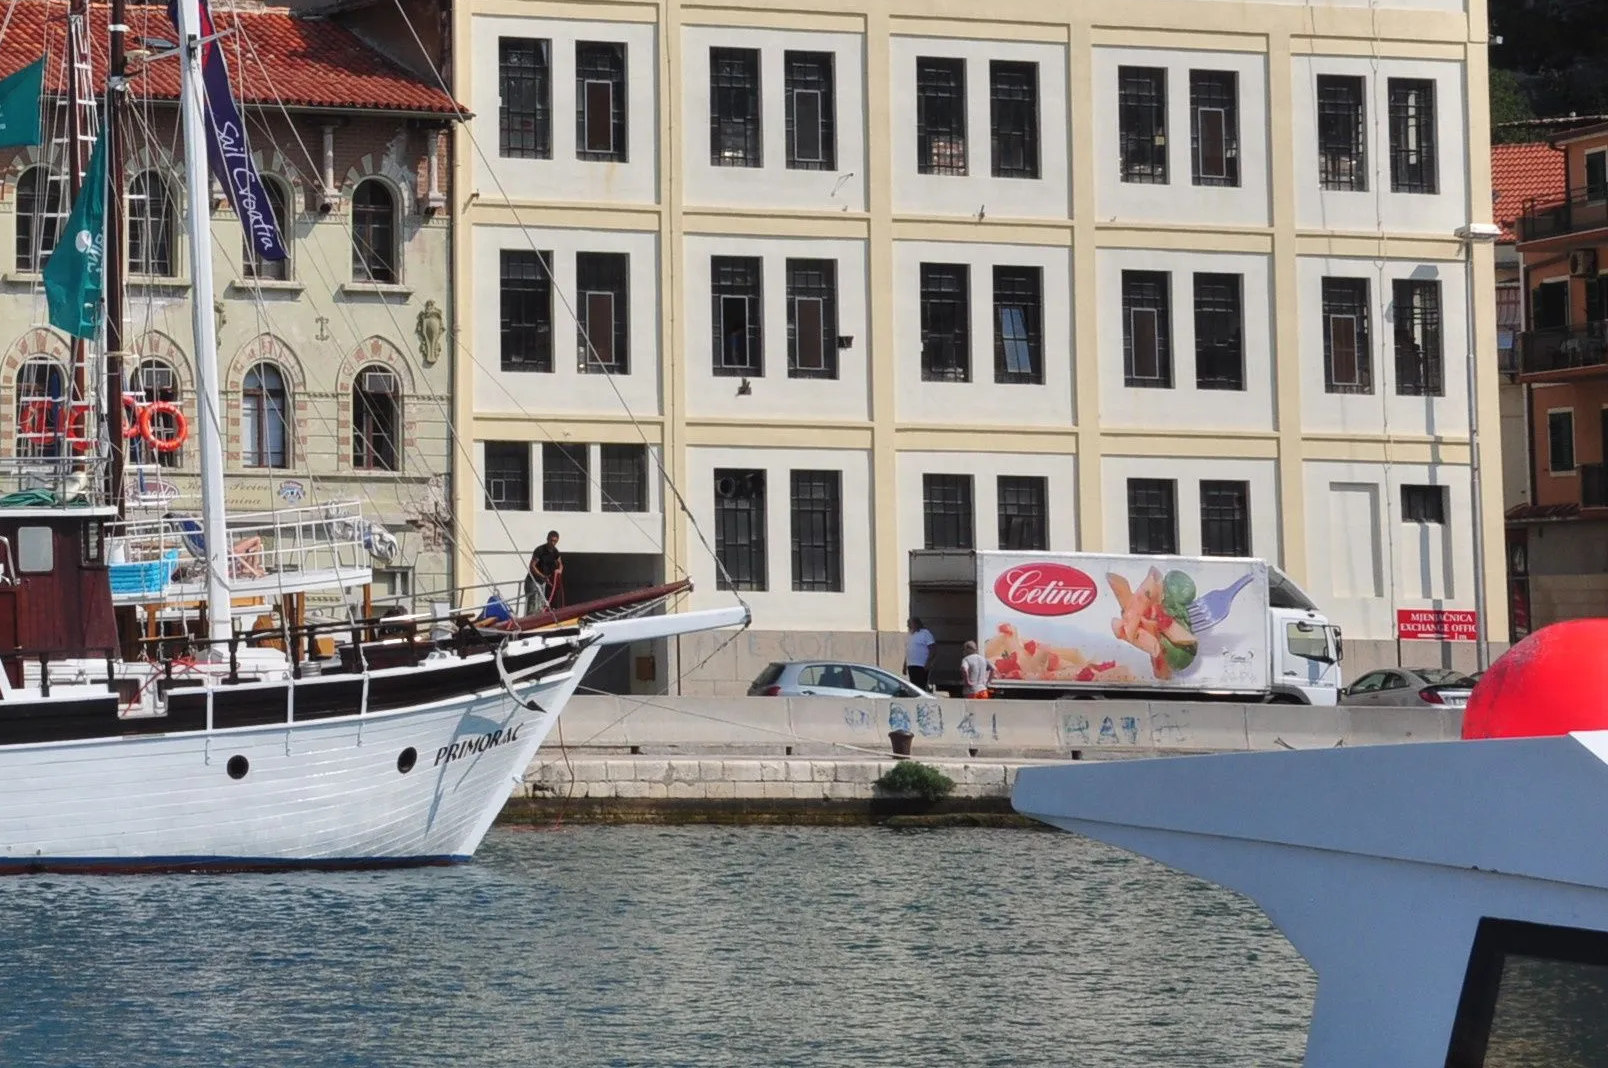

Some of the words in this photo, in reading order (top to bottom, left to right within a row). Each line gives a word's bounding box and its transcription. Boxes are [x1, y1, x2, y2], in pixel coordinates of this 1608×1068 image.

[217, 120, 248, 158] Sail
[233, 167, 274, 251] Croatia
[1400, 623, 1450, 632] EXCHANGE
[1452, 624, 1476, 632] OFFIC
[433, 722, 525, 767] PRIMORAC
